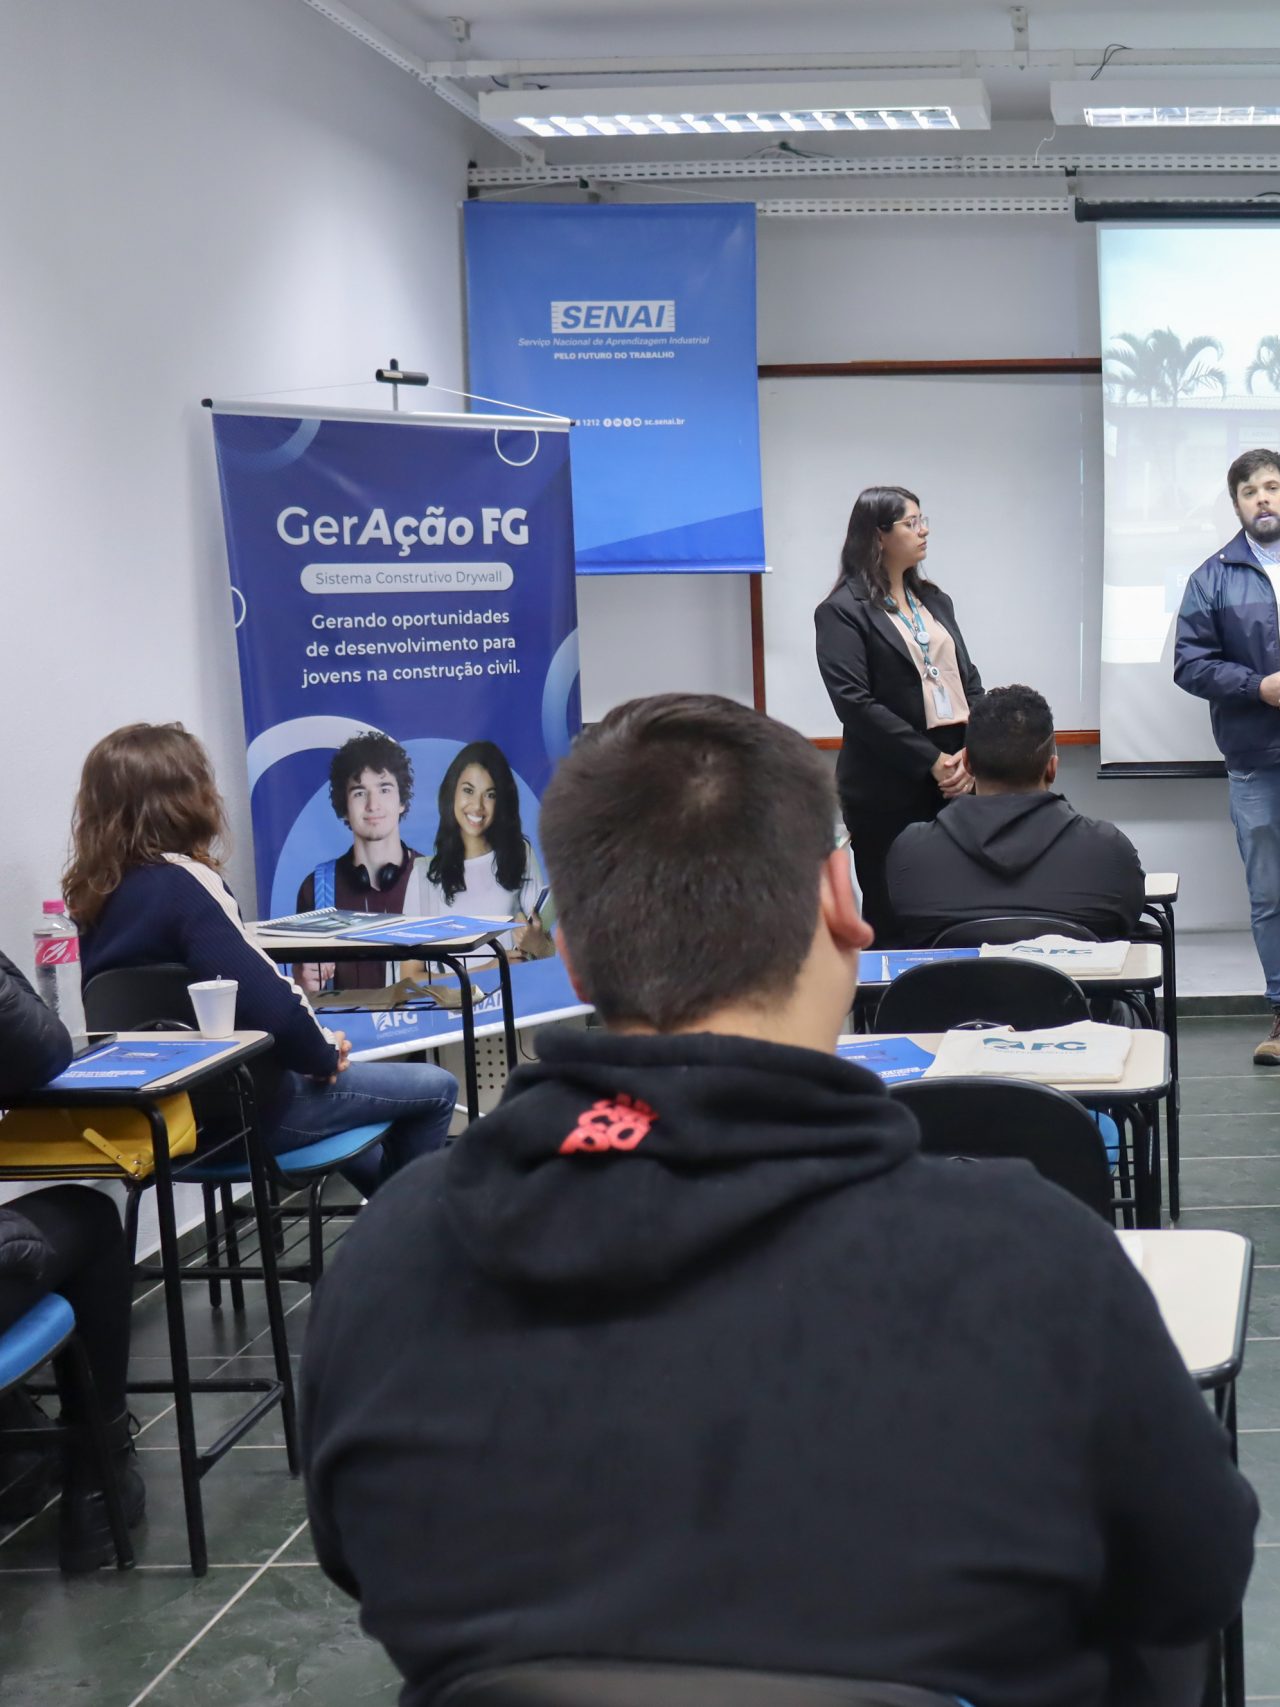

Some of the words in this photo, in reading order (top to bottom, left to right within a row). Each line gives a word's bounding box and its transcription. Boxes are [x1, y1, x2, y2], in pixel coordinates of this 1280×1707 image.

[561, 305, 666, 329] SENAI
[518, 337, 551, 347] Serviço
[553, 337, 591, 346] Nacional
[592, 337, 604, 346] de
[605, 336, 667, 347] Aprendizagem
[669, 335, 710, 345] Industrial
[554, 352, 577, 360] PELO
[630, 351, 675, 359] TRABALHO
[276, 506, 474, 557] GerAção
[481, 507, 529, 545] FG
[316, 571, 372, 585] Sistema
[376, 570, 452, 585] Construtivo
[456, 570, 502, 586] Drywall
[312, 612, 387, 629] Gerando
[391, 609, 510, 630] oportunidades
[306, 640, 329, 657] de
[334, 636, 478, 656] desenvolvimento
[483, 637, 516, 653] para
[301, 668, 362, 689] jovens
[367, 668, 387, 682] na
[392, 661, 483, 681] construção
[487, 659, 521, 675] civil.
